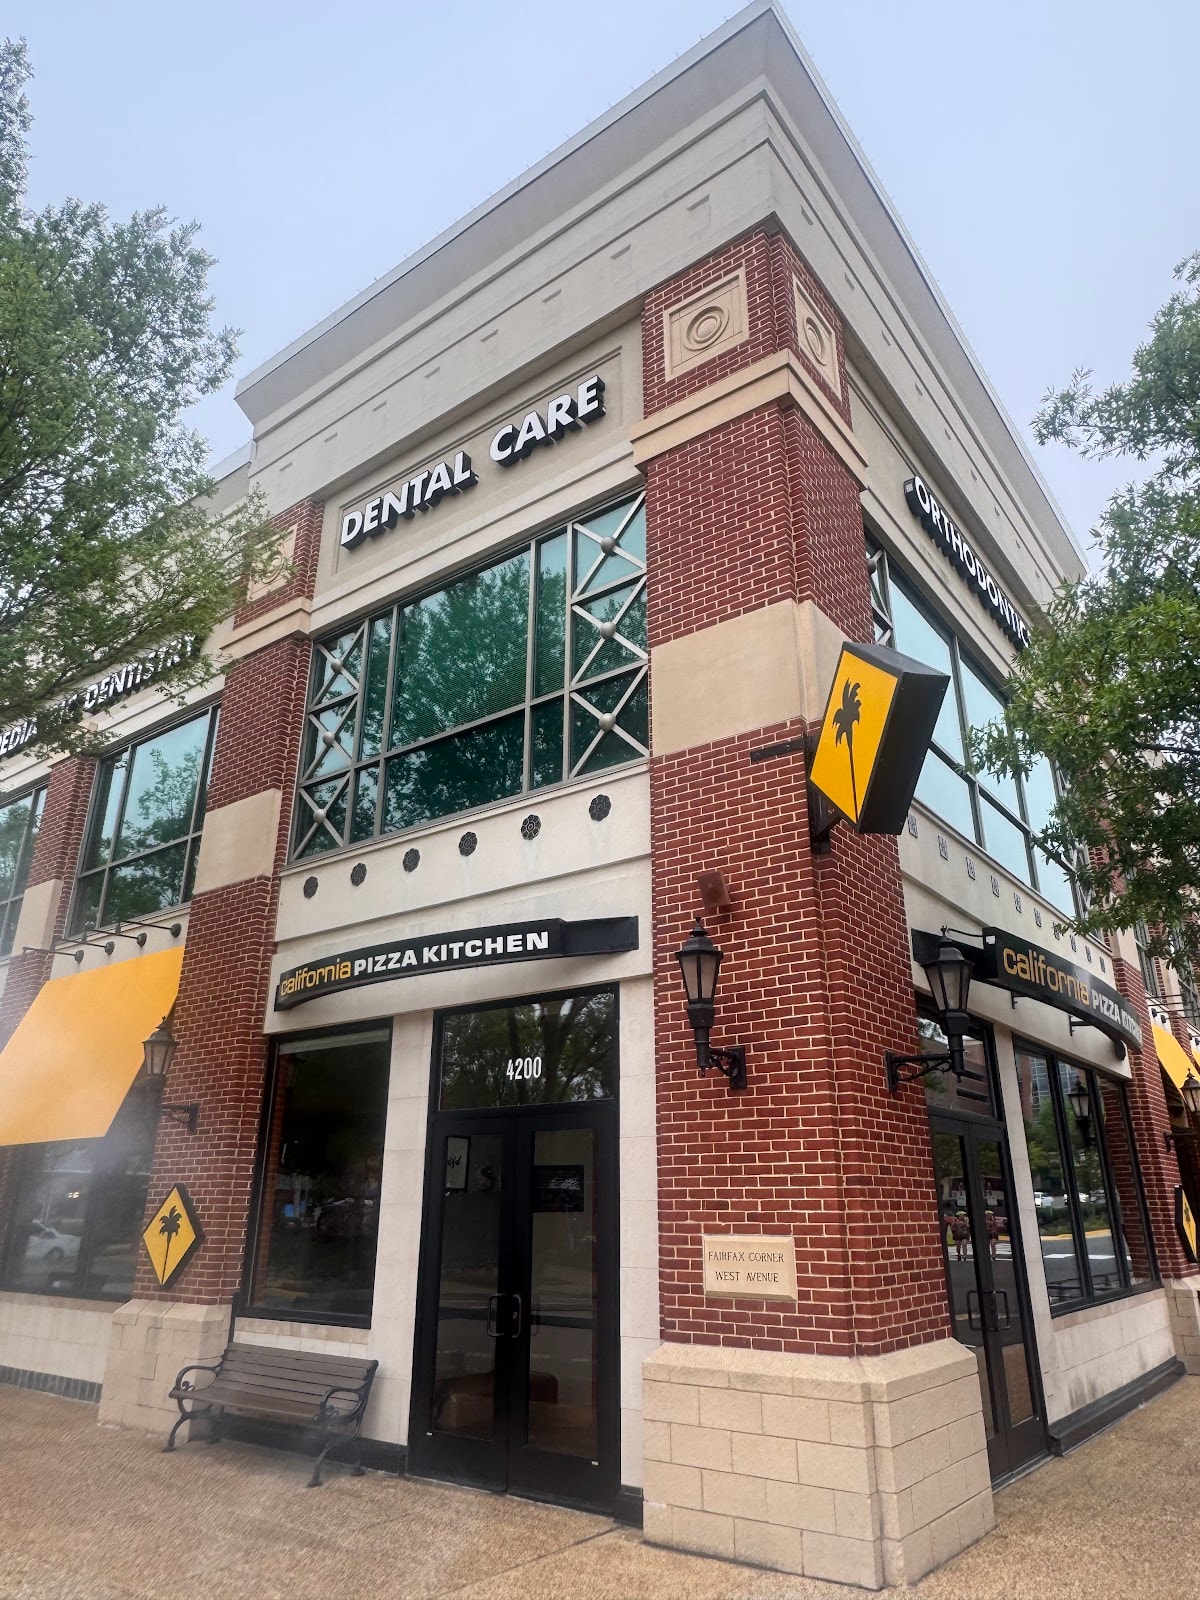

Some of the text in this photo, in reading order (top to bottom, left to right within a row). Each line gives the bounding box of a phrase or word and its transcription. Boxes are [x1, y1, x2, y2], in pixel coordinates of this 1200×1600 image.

[340, 375, 603, 548] DENTAL CARE
[914, 475, 1033, 649] ORTHODONTIC
[280, 931, 549, 996] california PIZZA KITCHEN
[1003, 947, 1143, 1047] california PIZZA KITC
[506, 1056, 542, 1081] 4200
[708, 1251, 785, 1263] FAIRFAX CORNER
[715, 1271, 780, 1283] WEST AVENUE
